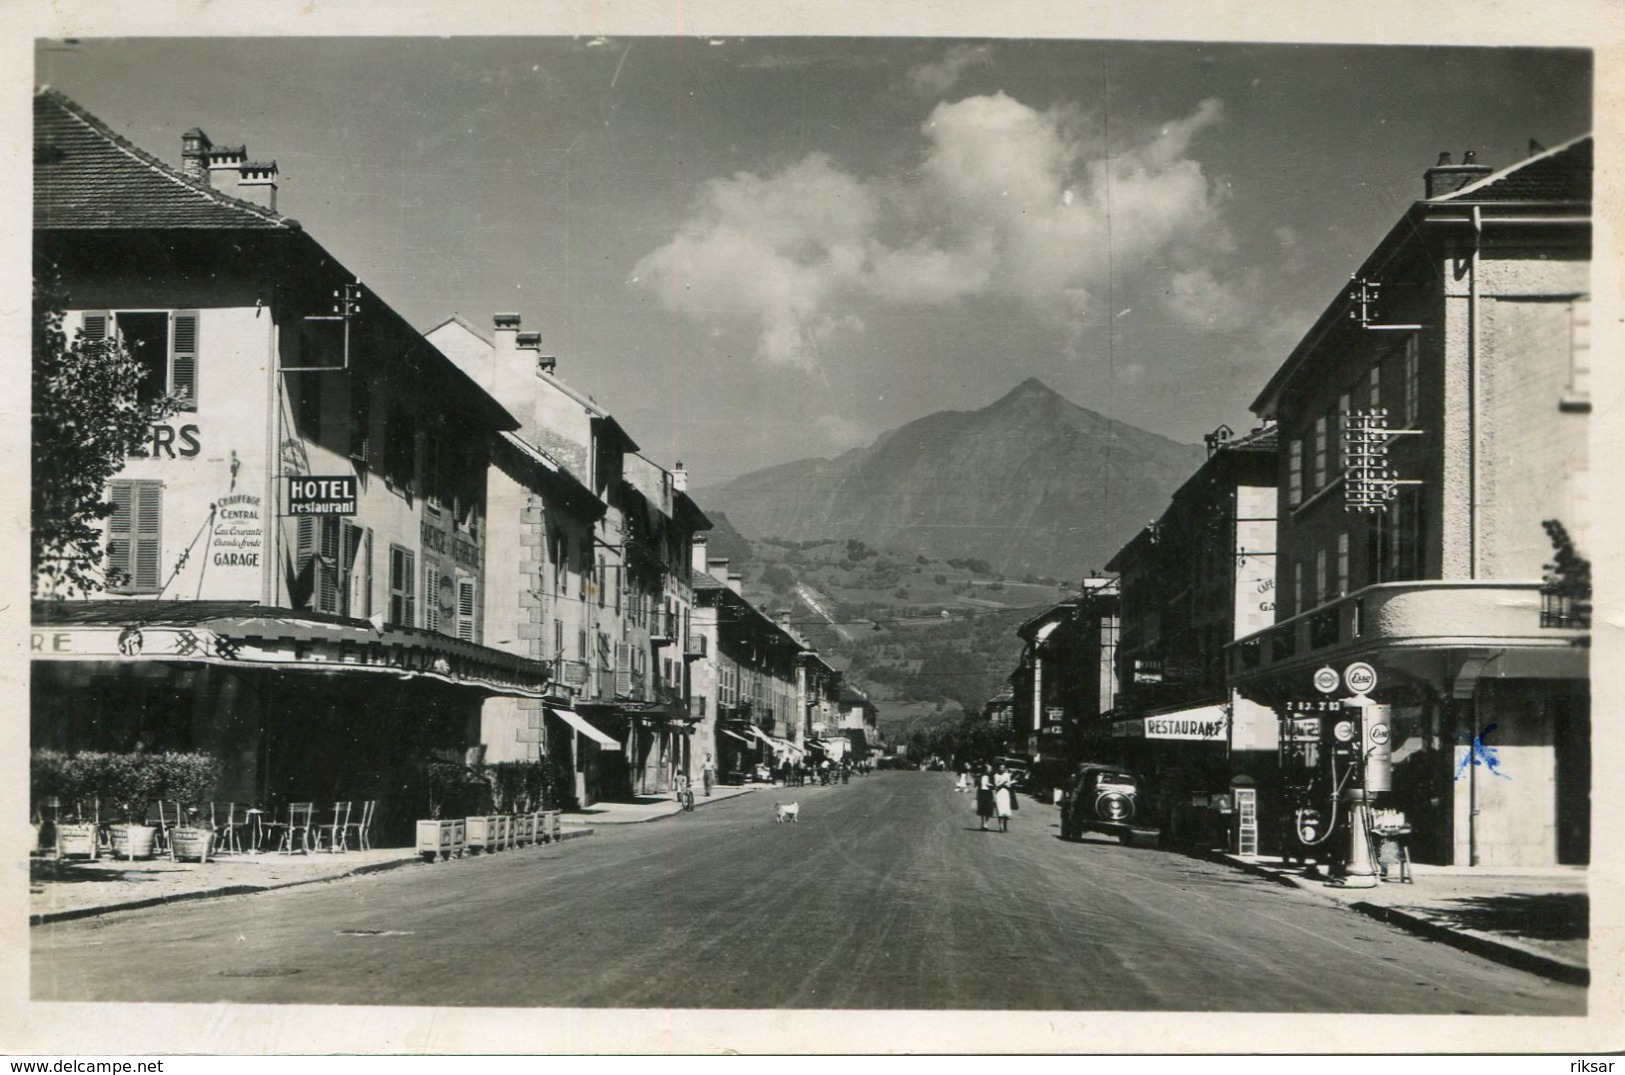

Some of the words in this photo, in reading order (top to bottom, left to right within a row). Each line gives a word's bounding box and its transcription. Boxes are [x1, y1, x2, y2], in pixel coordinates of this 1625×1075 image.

[291, 480, 354, 499] HOTEL
[217, 494, 261, 508] CHAUFFAGE
[291, 500, 354, 513] restaurant
[220, 508, 259, 519] CENTRAL
[214, 523, 229, 536] Eau
[214, 552, 260, 567] GARAGE
[1258, 601, 1276, 612] GA
[1351, 672, 1372, 684] Esso
[1147, 719, 1223, 737] RESTAURANT
